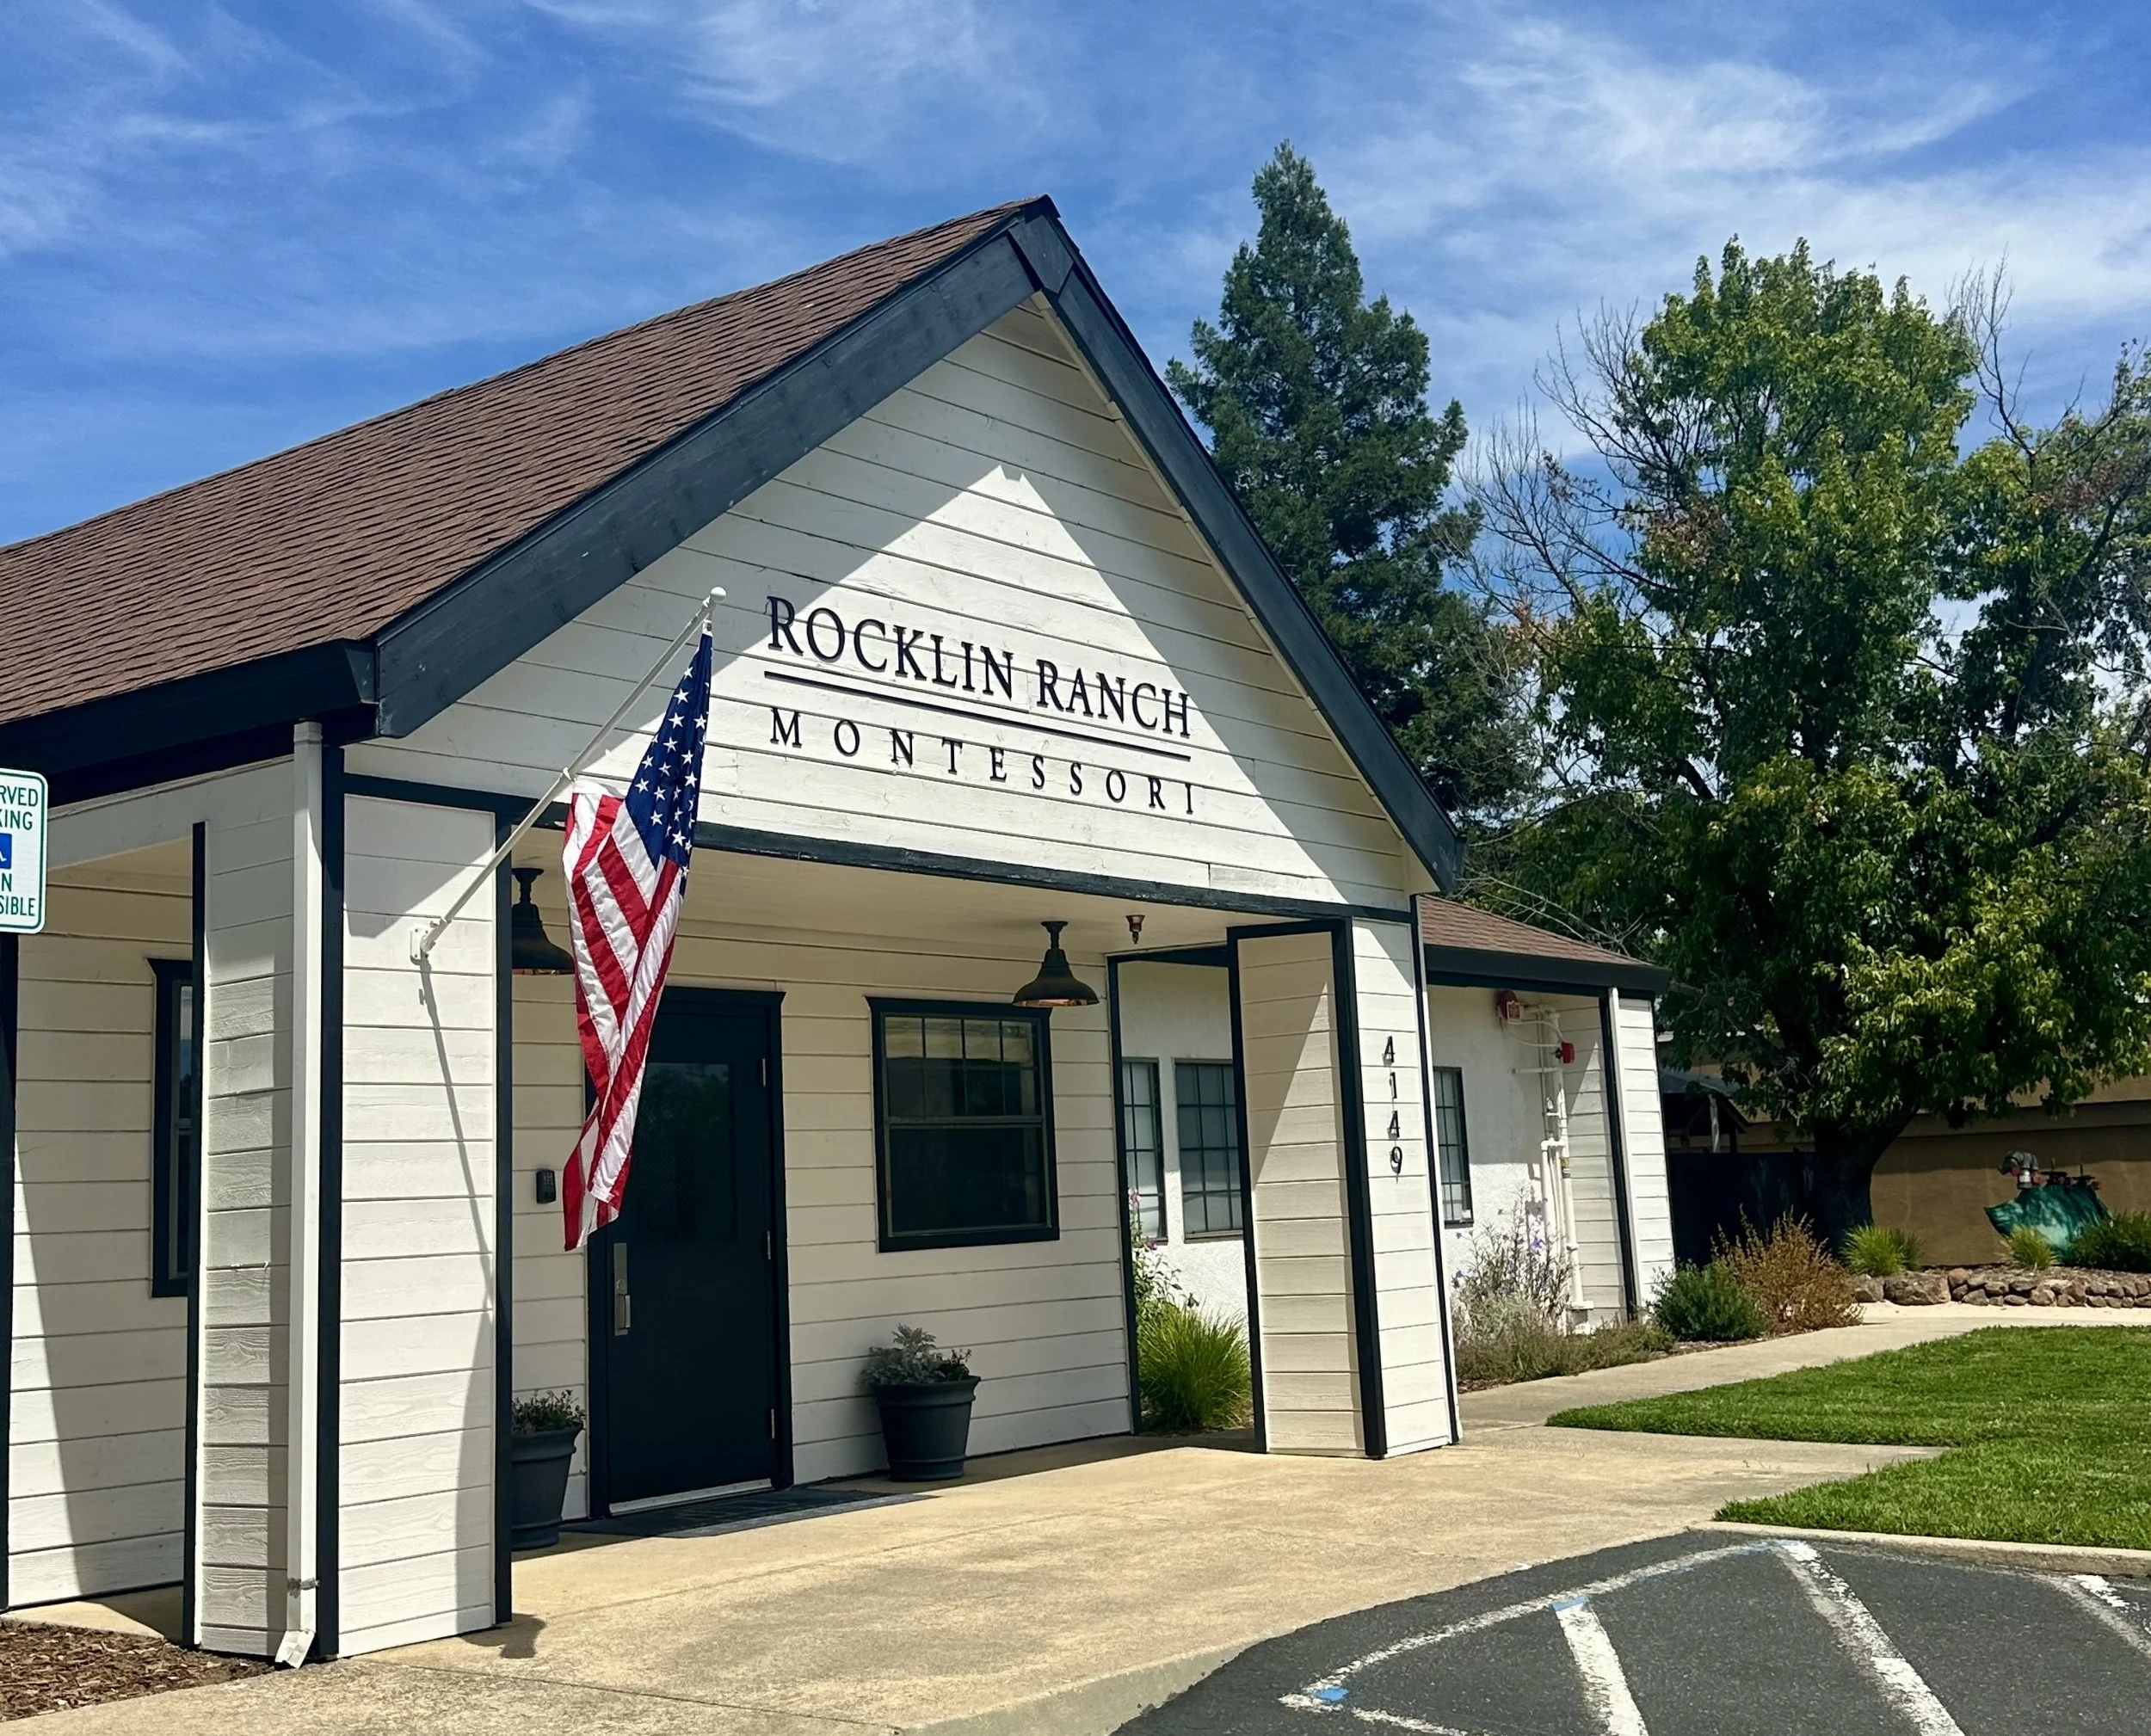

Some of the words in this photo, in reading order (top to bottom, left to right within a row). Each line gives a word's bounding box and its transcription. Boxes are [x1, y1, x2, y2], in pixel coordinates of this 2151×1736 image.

[767, 595, 1014, 699] ROCKLIN
[1036, 658, 1191, 737] RANCH
[0, 809, 33, 831] ING
[769, 707, 1193, 815] MONTESSORI
[1383, 1036, 1402, 1173] 4149
